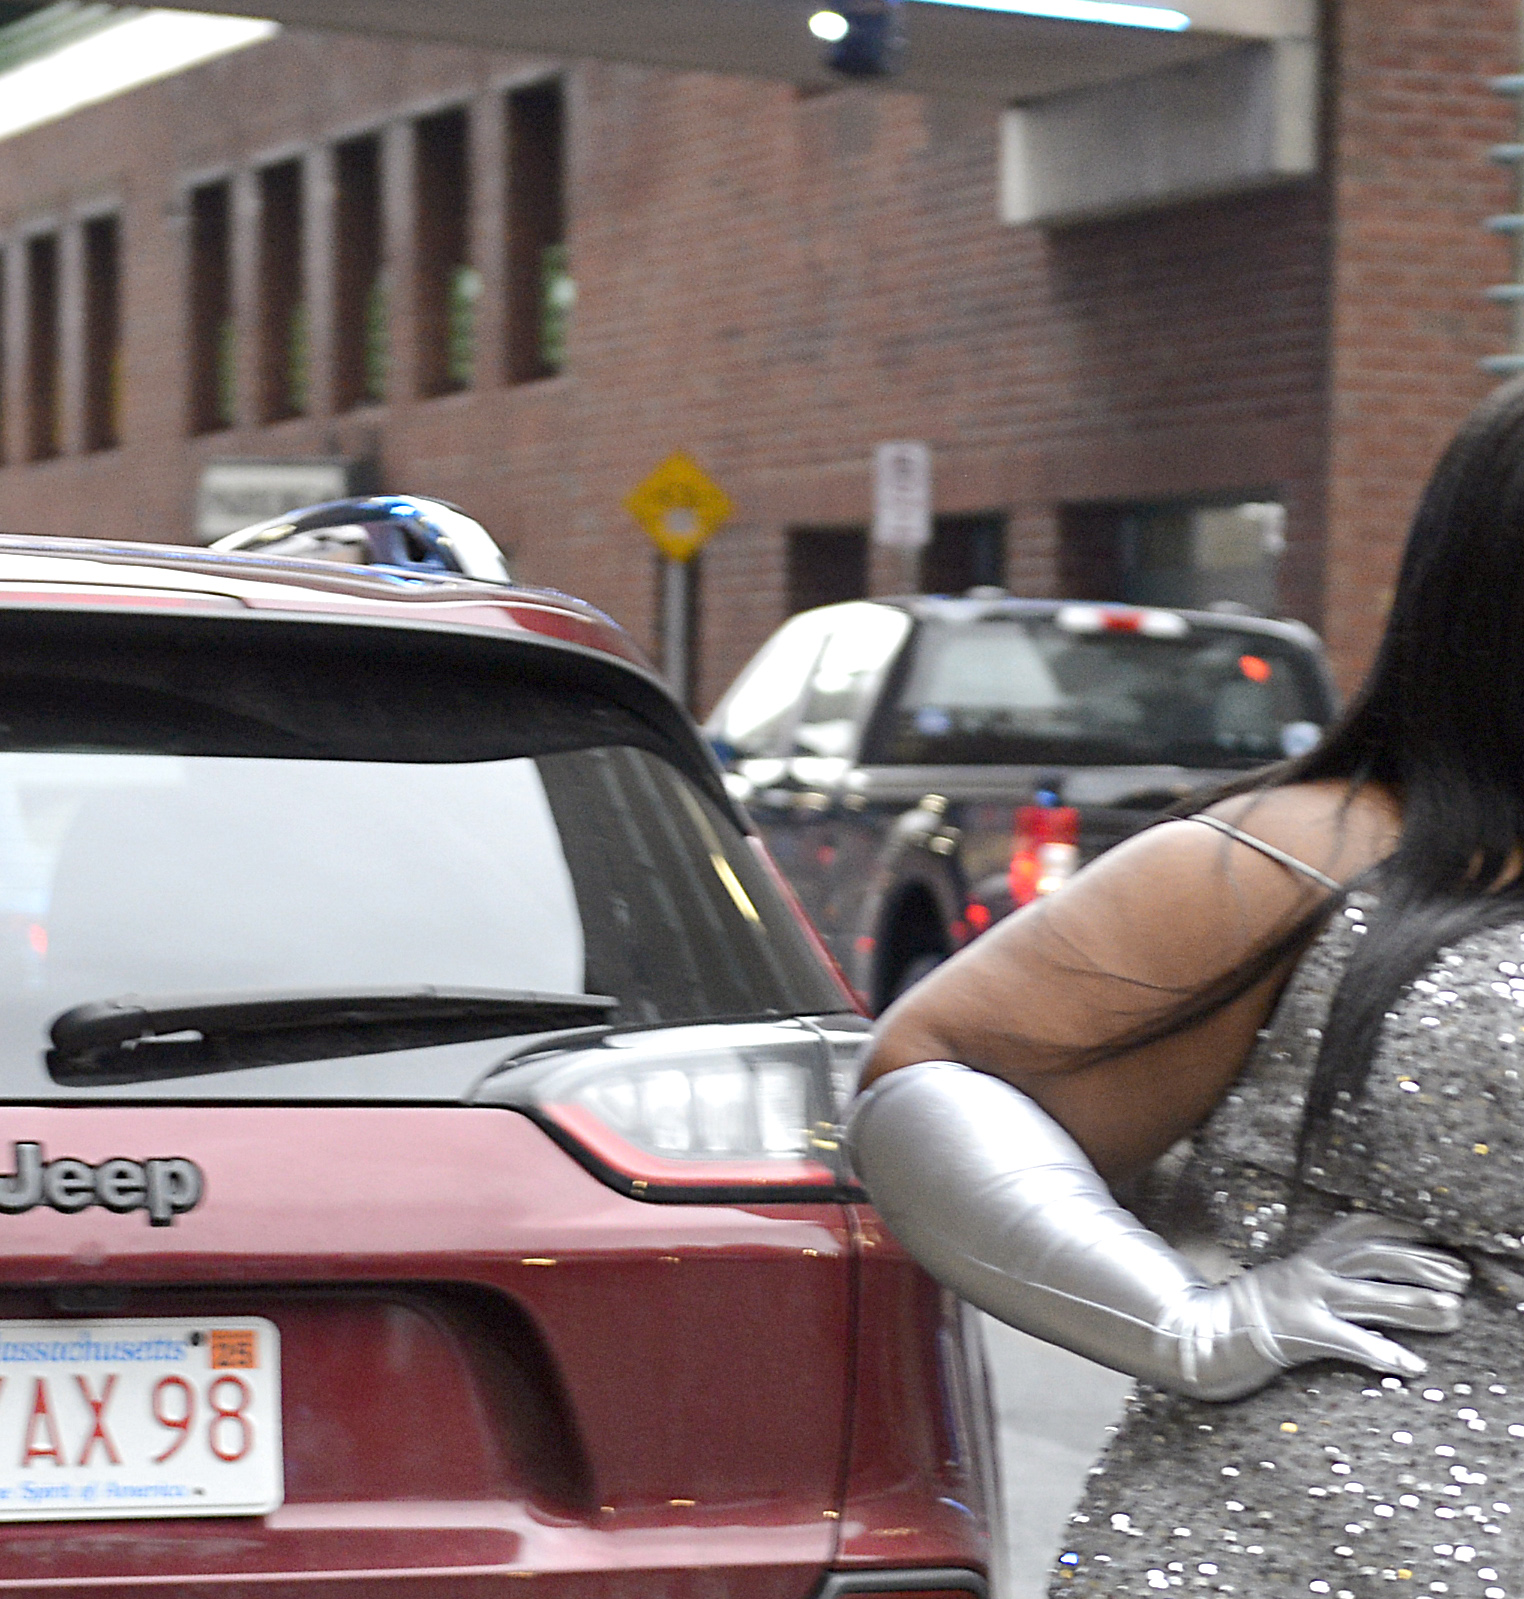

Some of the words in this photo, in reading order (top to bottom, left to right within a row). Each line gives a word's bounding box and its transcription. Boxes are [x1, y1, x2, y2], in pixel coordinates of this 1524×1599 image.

[0, 1140, 204, 1227] Jeep
[0, 1331, 187, 1362] assachusetts
[0, 1374, 121, 1467] AX
[151, 1374, 253, 1463] 98
